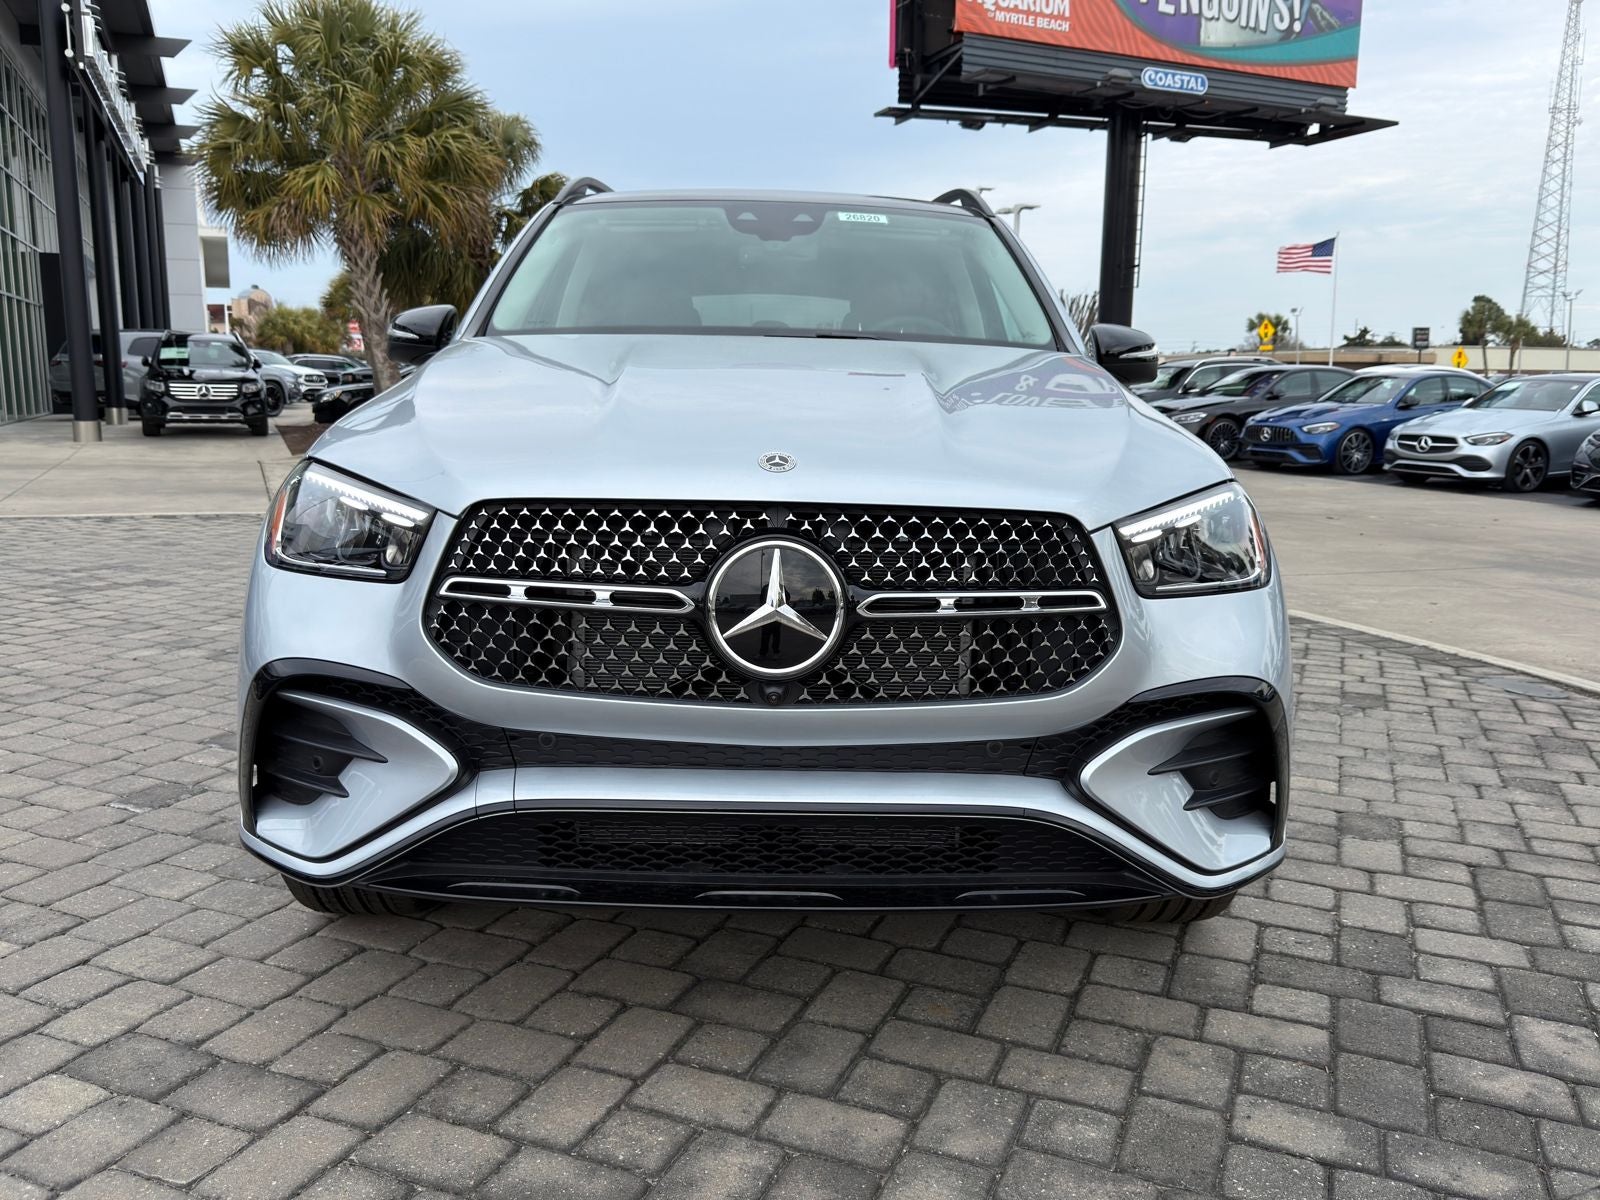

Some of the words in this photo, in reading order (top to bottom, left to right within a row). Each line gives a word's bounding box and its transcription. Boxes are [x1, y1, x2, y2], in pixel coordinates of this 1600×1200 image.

[966, 0, 1071, 17] ARIUM
[1140, 0, 1302, 33] GUINS!
[995, 10, 1035, 27] MYRTLE
[1036, 16, 1070, 32] BEACH
[1144, 70, 1204, 91] COASTAL
